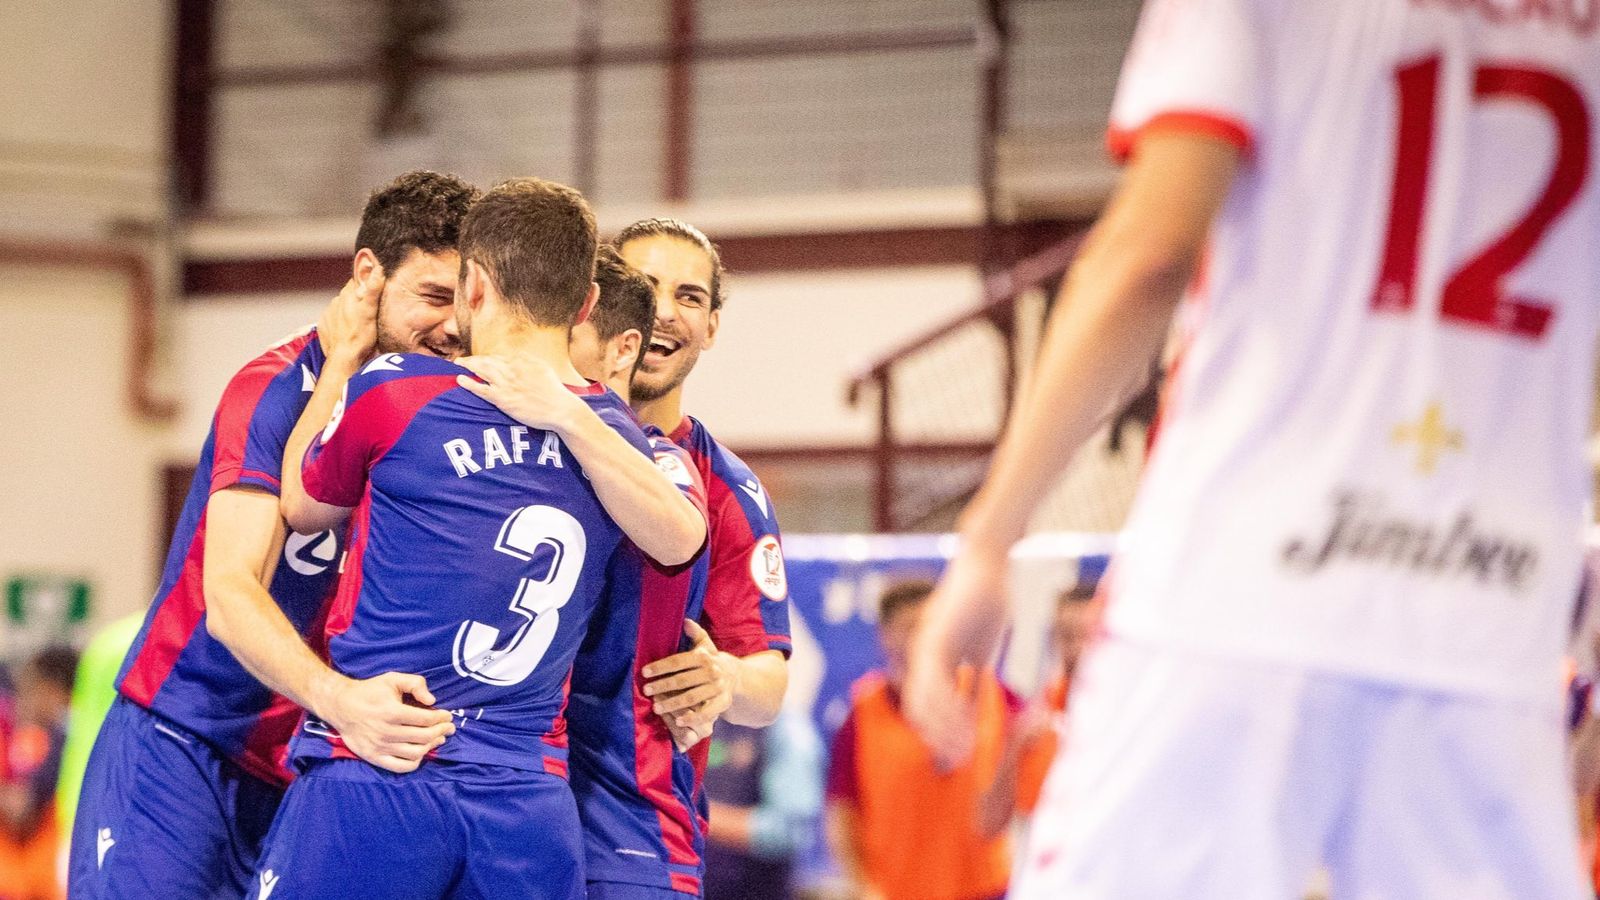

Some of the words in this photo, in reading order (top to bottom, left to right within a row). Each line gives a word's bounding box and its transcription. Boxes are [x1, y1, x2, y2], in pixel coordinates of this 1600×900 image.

[1368, 49, 1592, 340] 12
[443, 425, 564, 478] RAFA
[452, 504, 587, 686] 3
